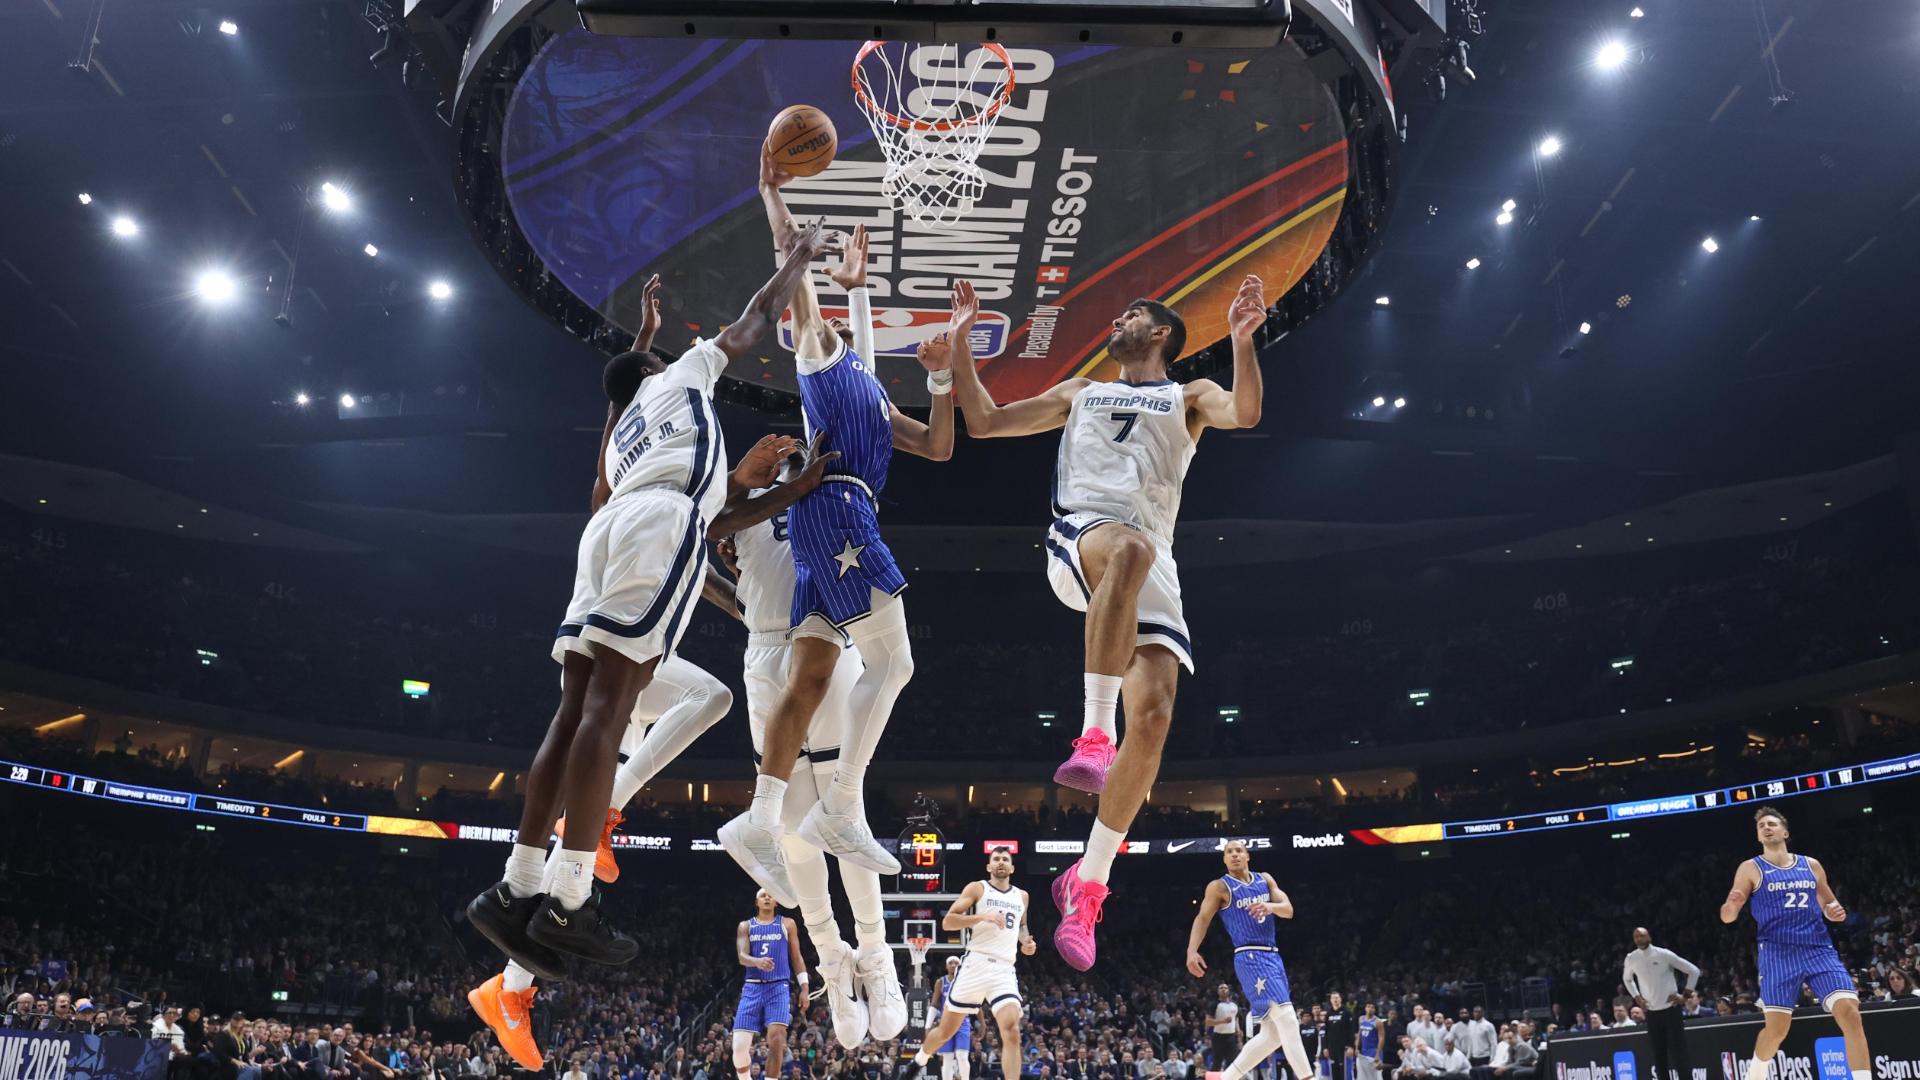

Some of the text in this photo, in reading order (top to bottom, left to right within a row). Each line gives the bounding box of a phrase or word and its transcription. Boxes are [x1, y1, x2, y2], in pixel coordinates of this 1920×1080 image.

[788, 132, 831, 156] Wilson
[898, 45, 1055, 301] GAME 2026
[1041, 148, 1098, 262] TISSOT
[775, 160, 895, 298] BERLIN
[967, 330, 992, 352] NBA
[1018, 317, 1056, 358] Presented
[1084, 396, 1172, 413] MEMPHIS
[614, 402, 646, 454] 5
[659, 421, 679, 440] JR.
[1111, 412, 1138, 443] 7
[1763, 539, 1799, 561] 407
[1533, 592, 1568, 611] 408
[1340, 618, 1373, 636] 409
[1868, 762, 1906, 776] MEMPHIS
[109, 786, 186, 805] MEMPHIS GRIZZLIES
[216, 801, 270, 817] TIMEOUTS 2
[1617, 799, 1690, 817] ORLANDO MAGIC
[302, 813, 341, 826] FOULS 2
[1464, 820, 1515, 834] TIMEOUTS 2
[1545, 811, 1585, 825] FOULS 4
[626, 836, 671, 846] TISSOT
[1293, 833, 1344, 848] Revolut
[916, 846, 935, 866] 19
[986, 898, 1022, 912] MEMPHIS
[1236, 893, 1270, 909] ORLAND
[1784, 893, 1809, 908] 22
[760, 943, 769, 955] 5
[0, 1036, 70, 1080] ME 2026
[1777, 1050, 1813, 1080] Pass
[1822, 1050, 1845, 1062] prime
[1692, 1067, 1707, 1080] ow
[1825, 1064, 1847, 1076] video
[1875, 1055, 1910, 1080] Sign
